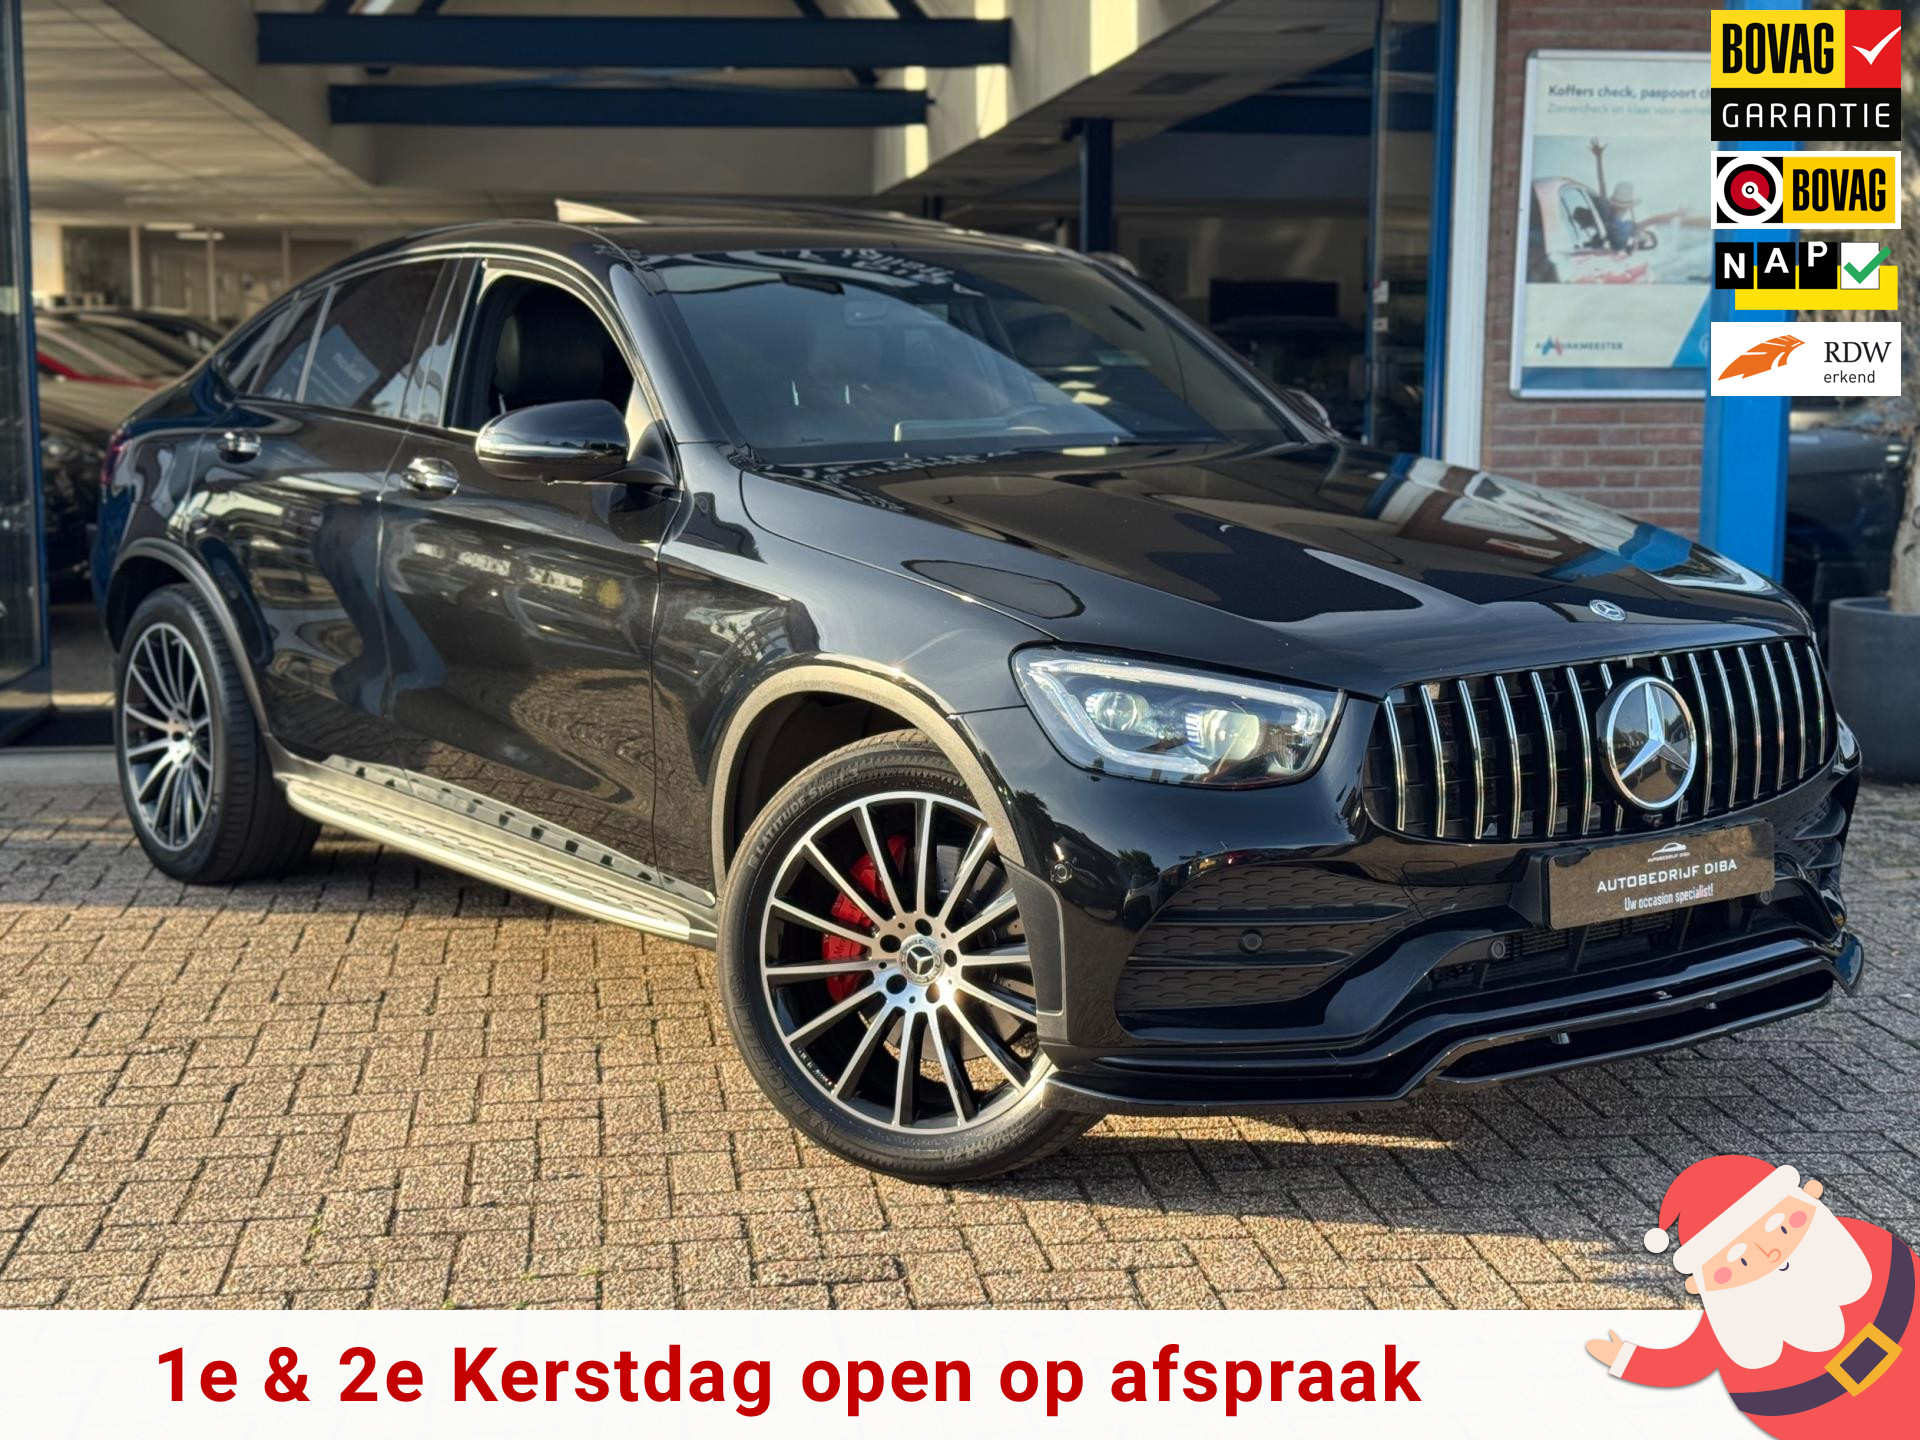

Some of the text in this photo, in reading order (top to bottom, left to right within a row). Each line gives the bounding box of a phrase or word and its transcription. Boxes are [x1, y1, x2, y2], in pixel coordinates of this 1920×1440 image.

[1548, 84, 1594, 97] Koffers
[1597, 85, 1637, 99] check,
[1640, 87, 1696, 102] paspoort
[756, 795, 807, 856] LATITUDE
[808, 773, 845, 800] Sport
[1597, 859, 1737, 893] AUTOBEDRIJF DIBA
[1624, 882, 1714, 911] Uw occasion specialist!
